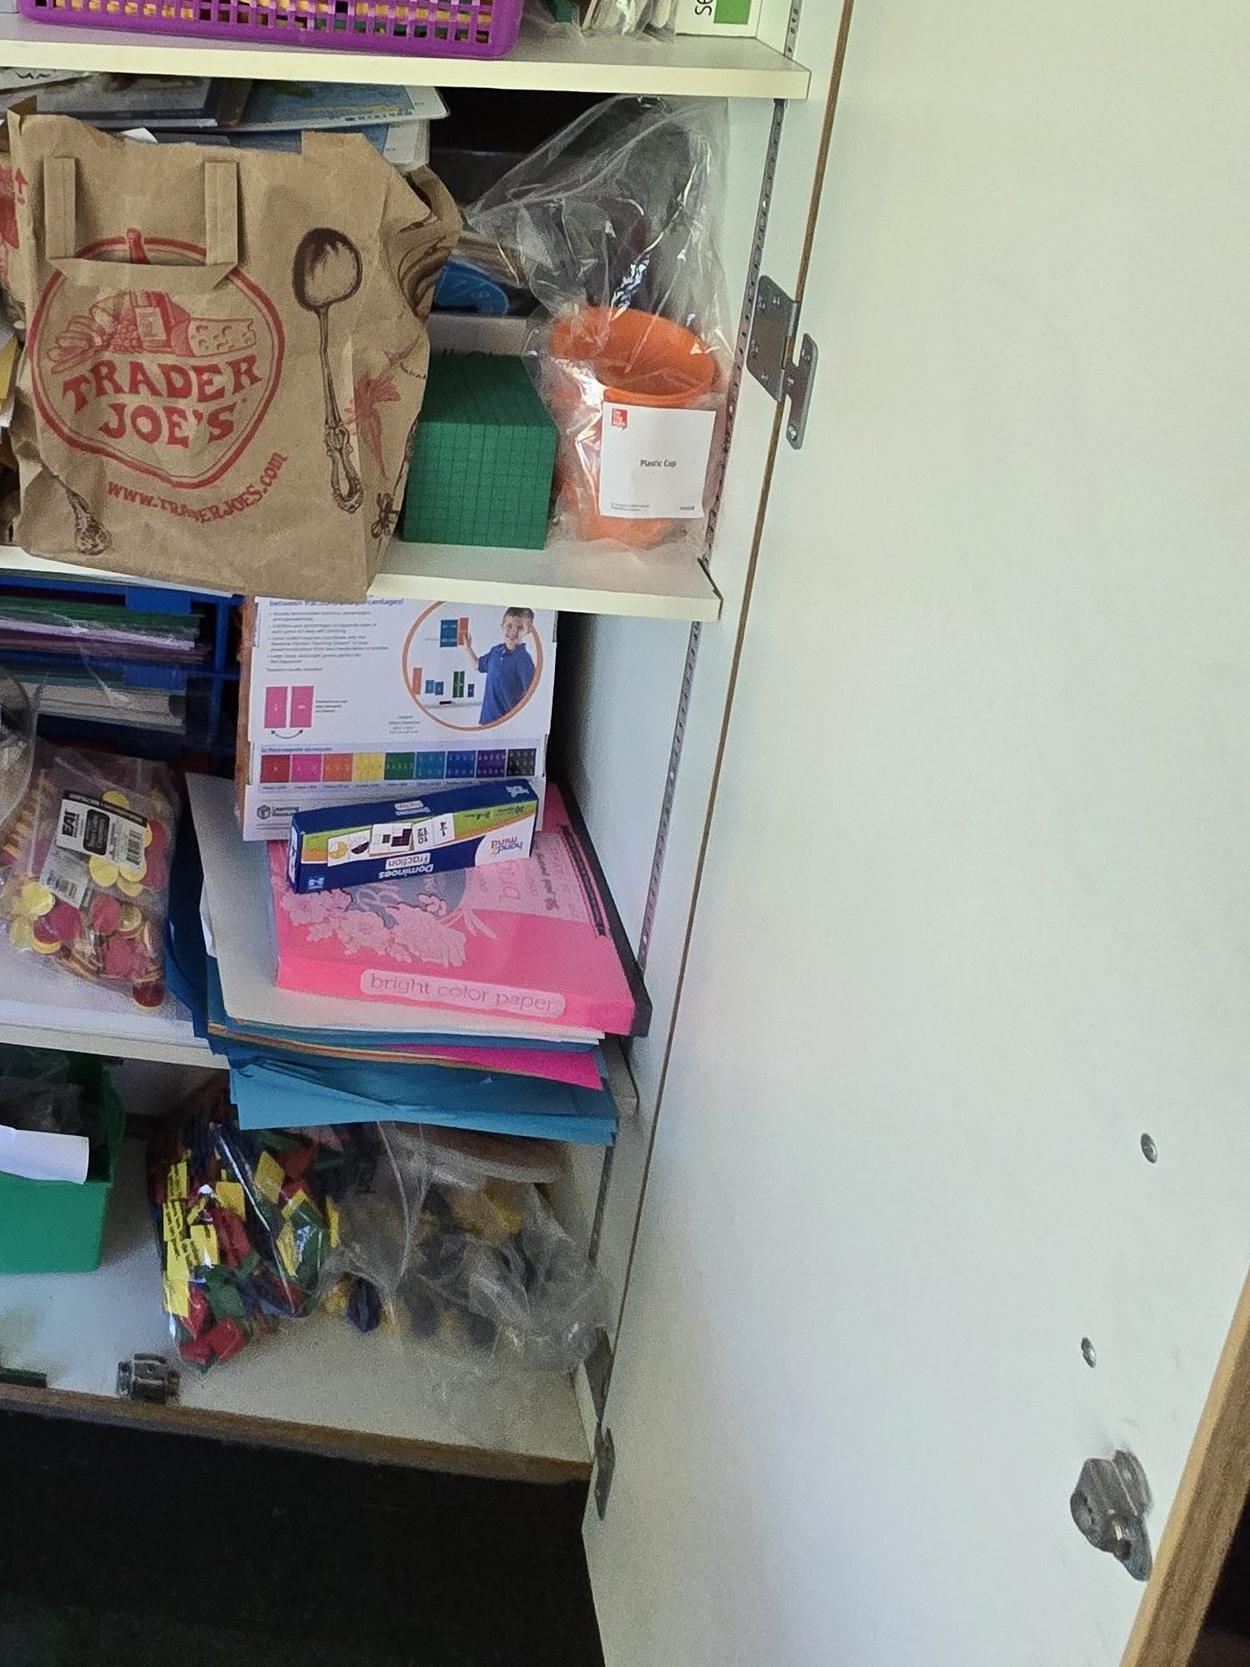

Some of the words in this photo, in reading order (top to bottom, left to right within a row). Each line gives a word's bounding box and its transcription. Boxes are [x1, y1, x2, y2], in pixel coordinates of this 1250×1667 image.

[62, 354, 263, 415] TRADER
[100, 401, 238, 449] JOE'S
[640, 459, 662, 468] Plastic
[664, 460, 677, 469] Cup
[378, 863, 435, 880] Dominoes
[370, 973, 430, 995] bright
[437, 984, 489, 1003] color
[495, 991, 557, 1011] paper
